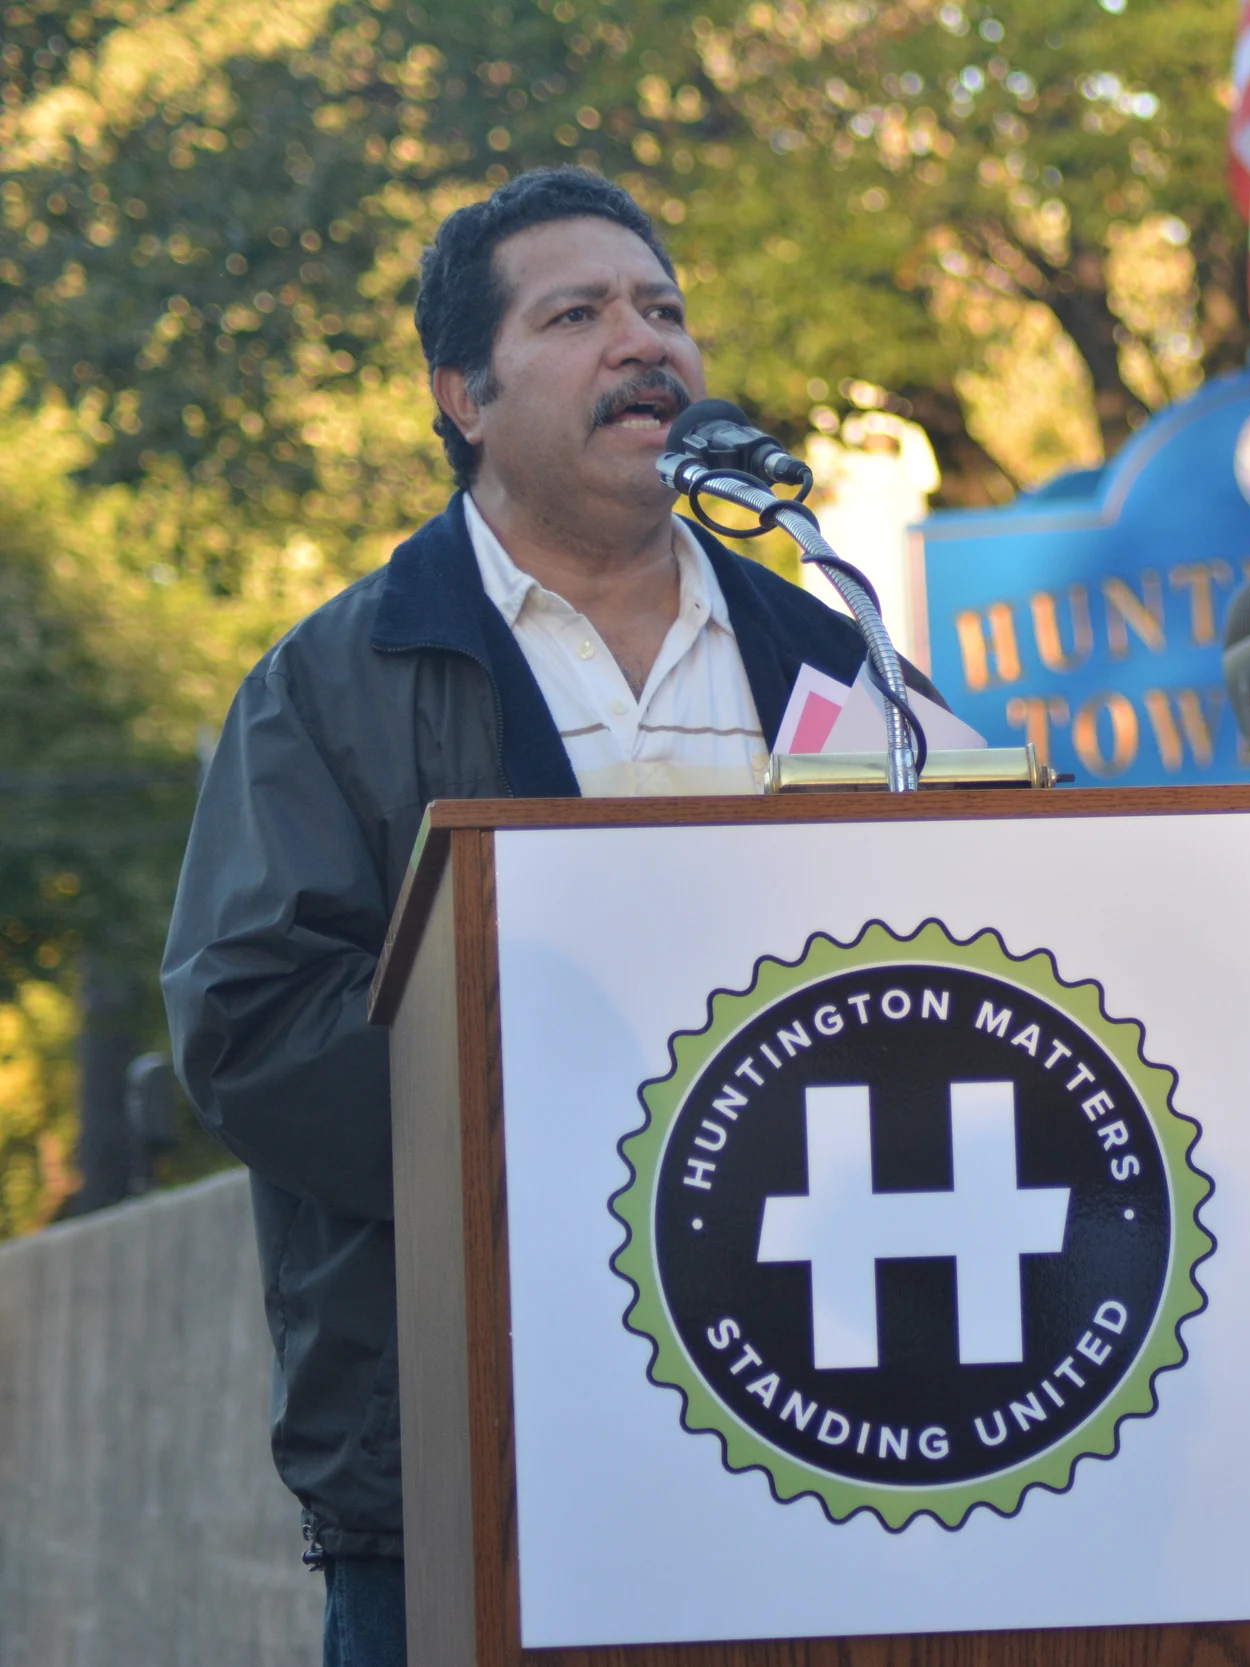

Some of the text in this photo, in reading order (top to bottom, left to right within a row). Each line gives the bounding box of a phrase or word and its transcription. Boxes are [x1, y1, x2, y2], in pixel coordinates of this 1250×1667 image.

[683, 989, 1140, 1189] HUNTINGTON MATTERS
[706, 1298, 1129, 1460] STANDING UNITED
